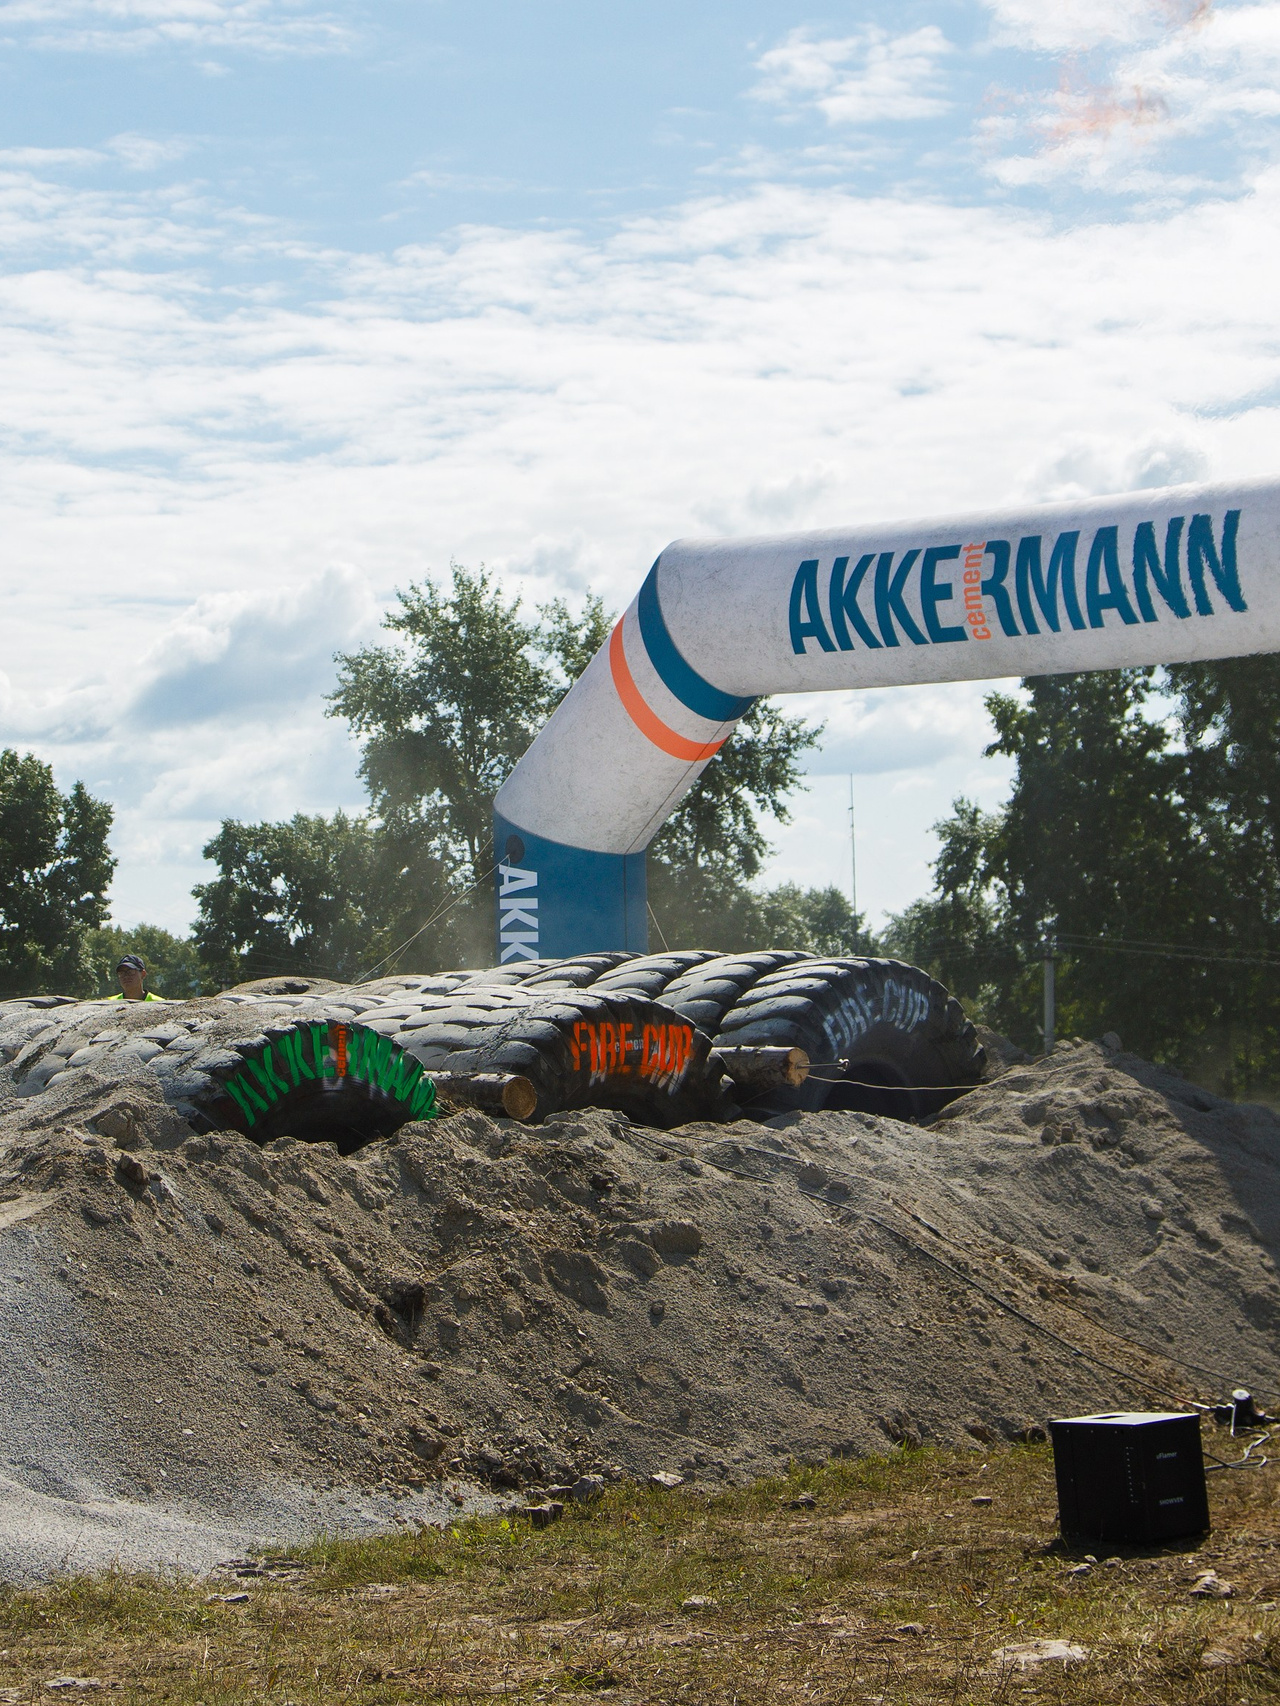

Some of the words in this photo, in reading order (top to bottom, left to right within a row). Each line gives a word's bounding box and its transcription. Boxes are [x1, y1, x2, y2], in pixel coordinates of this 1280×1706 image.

[788, 509, 1248, 656] AKKERMANN
[962, 541, 991, 641] cement
[571, 1022, 634, 1074] FIRE
[639, 1023, 694, 1077] CUP
[822, 983, 882, 1060] FIRE
[882, 978, 930, 1033] CUP
